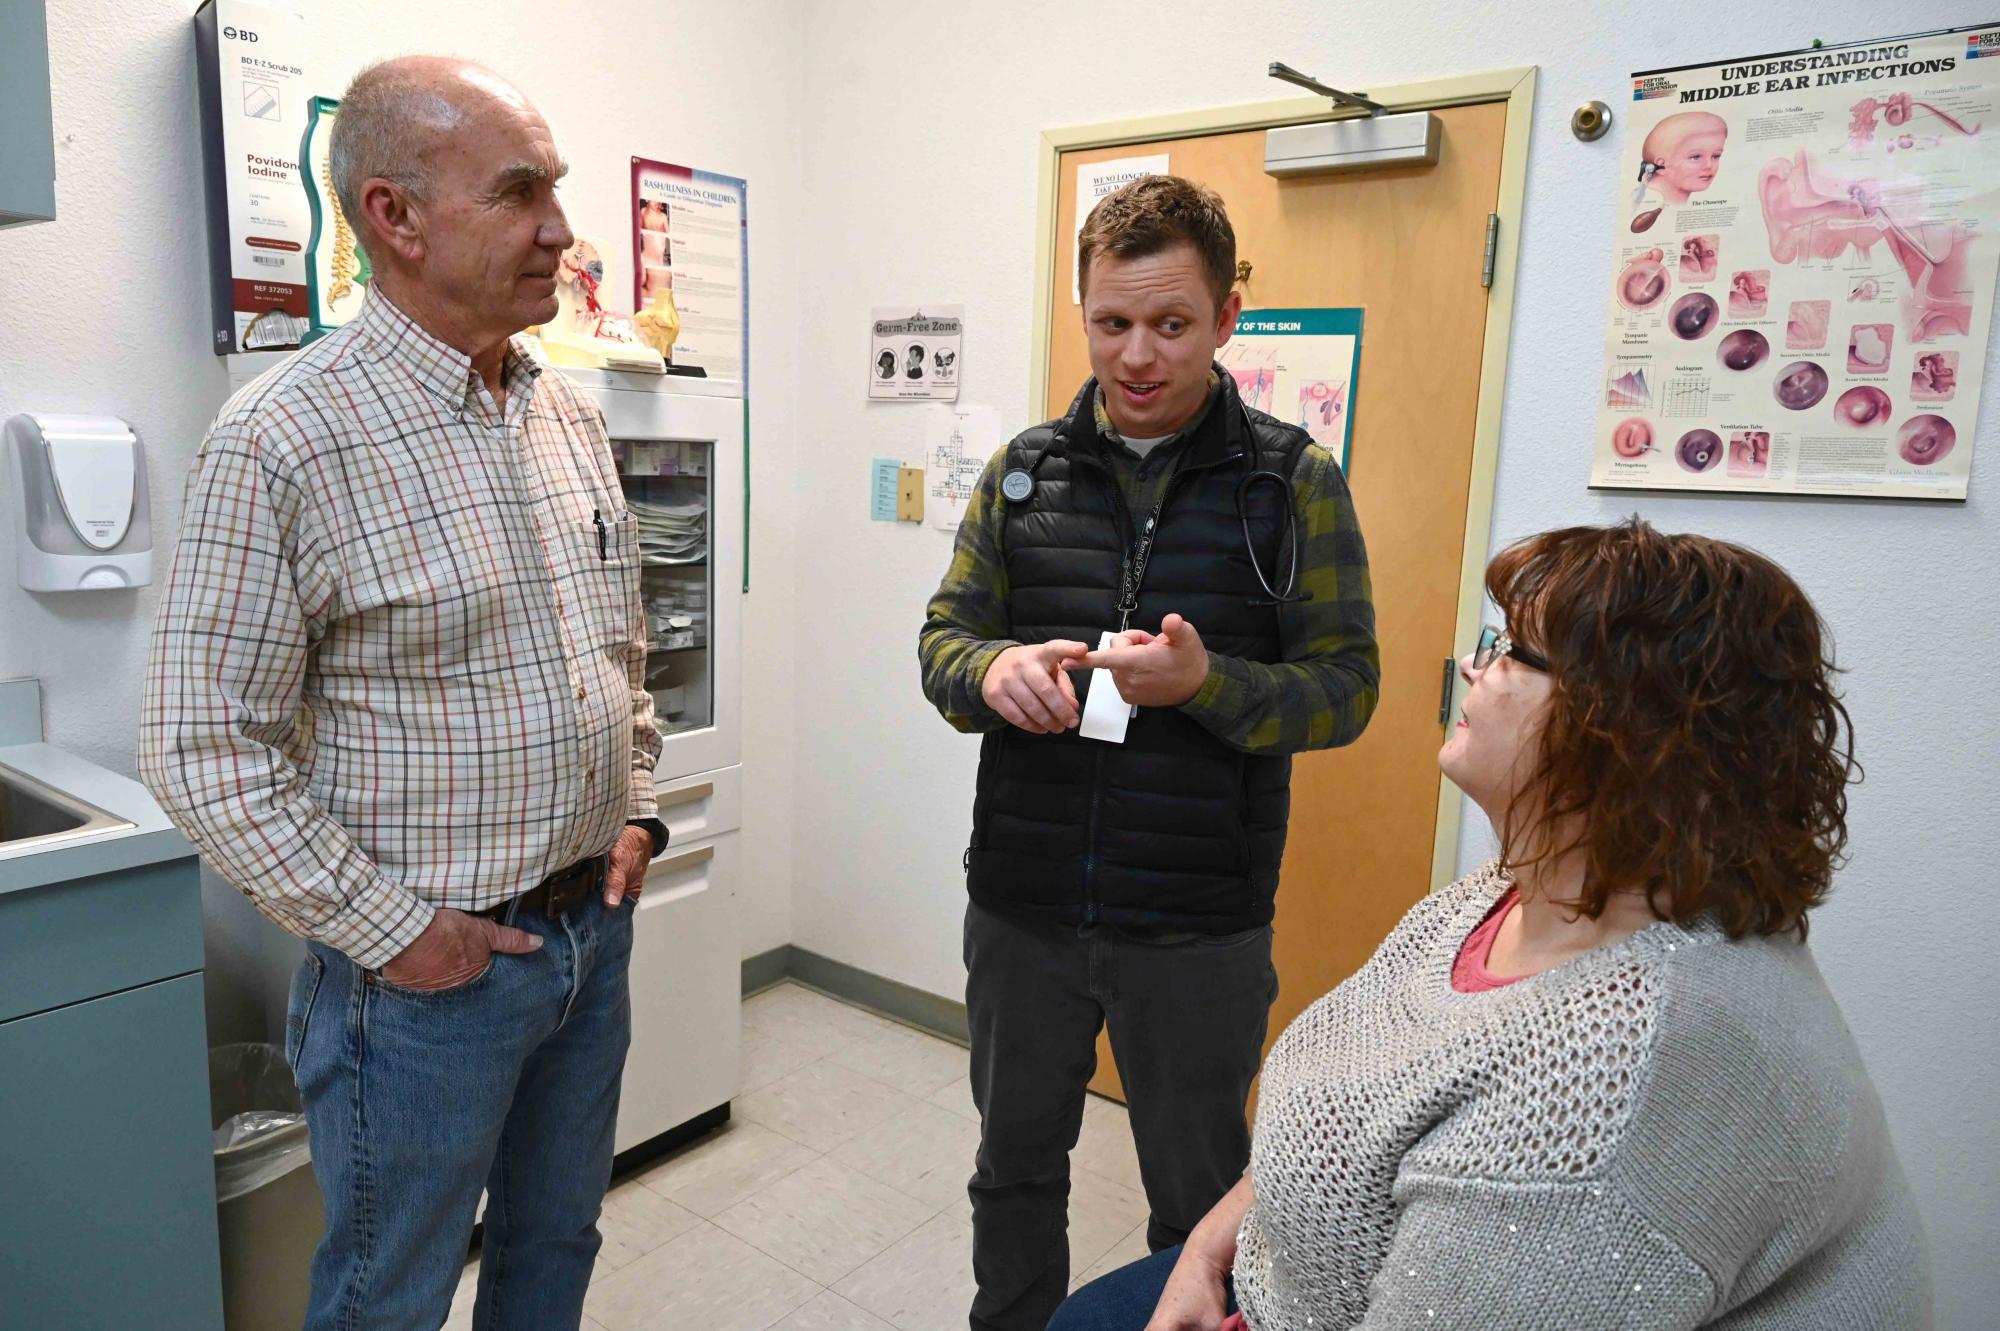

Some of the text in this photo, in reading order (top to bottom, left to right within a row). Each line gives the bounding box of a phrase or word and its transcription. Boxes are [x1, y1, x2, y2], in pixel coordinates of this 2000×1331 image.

[240, 30, 258, 43] BD
[241, 56, 253, 64] BD
[254, 59, 267, 67] E-Z
[268, 61, 288, 72] Scrub
[1721, 44, 1909, 81] UNDERSTANDING
[1679, 82, 1760, 104] MIDDLE
[1765, 76, 1810, 93] EAR
[1816, 57, 1956, 87] INFECTIONS
[247, 153, 300, 170] Povidon
[248, 165, 287, 180] Iodine
[1093, 177, 1104, 185] WE
[644, 179, 737, 204] RASH/ILLNESS IN CHILDREN
[254, 284, 267, 292] REF
[876, 321, 958, 333] Germ-Free Zone
[1242, 322, 1255, 331] OF
[1257, 322, 1276, 331] THE
[1278, 322, 1302, 331] SKIN
